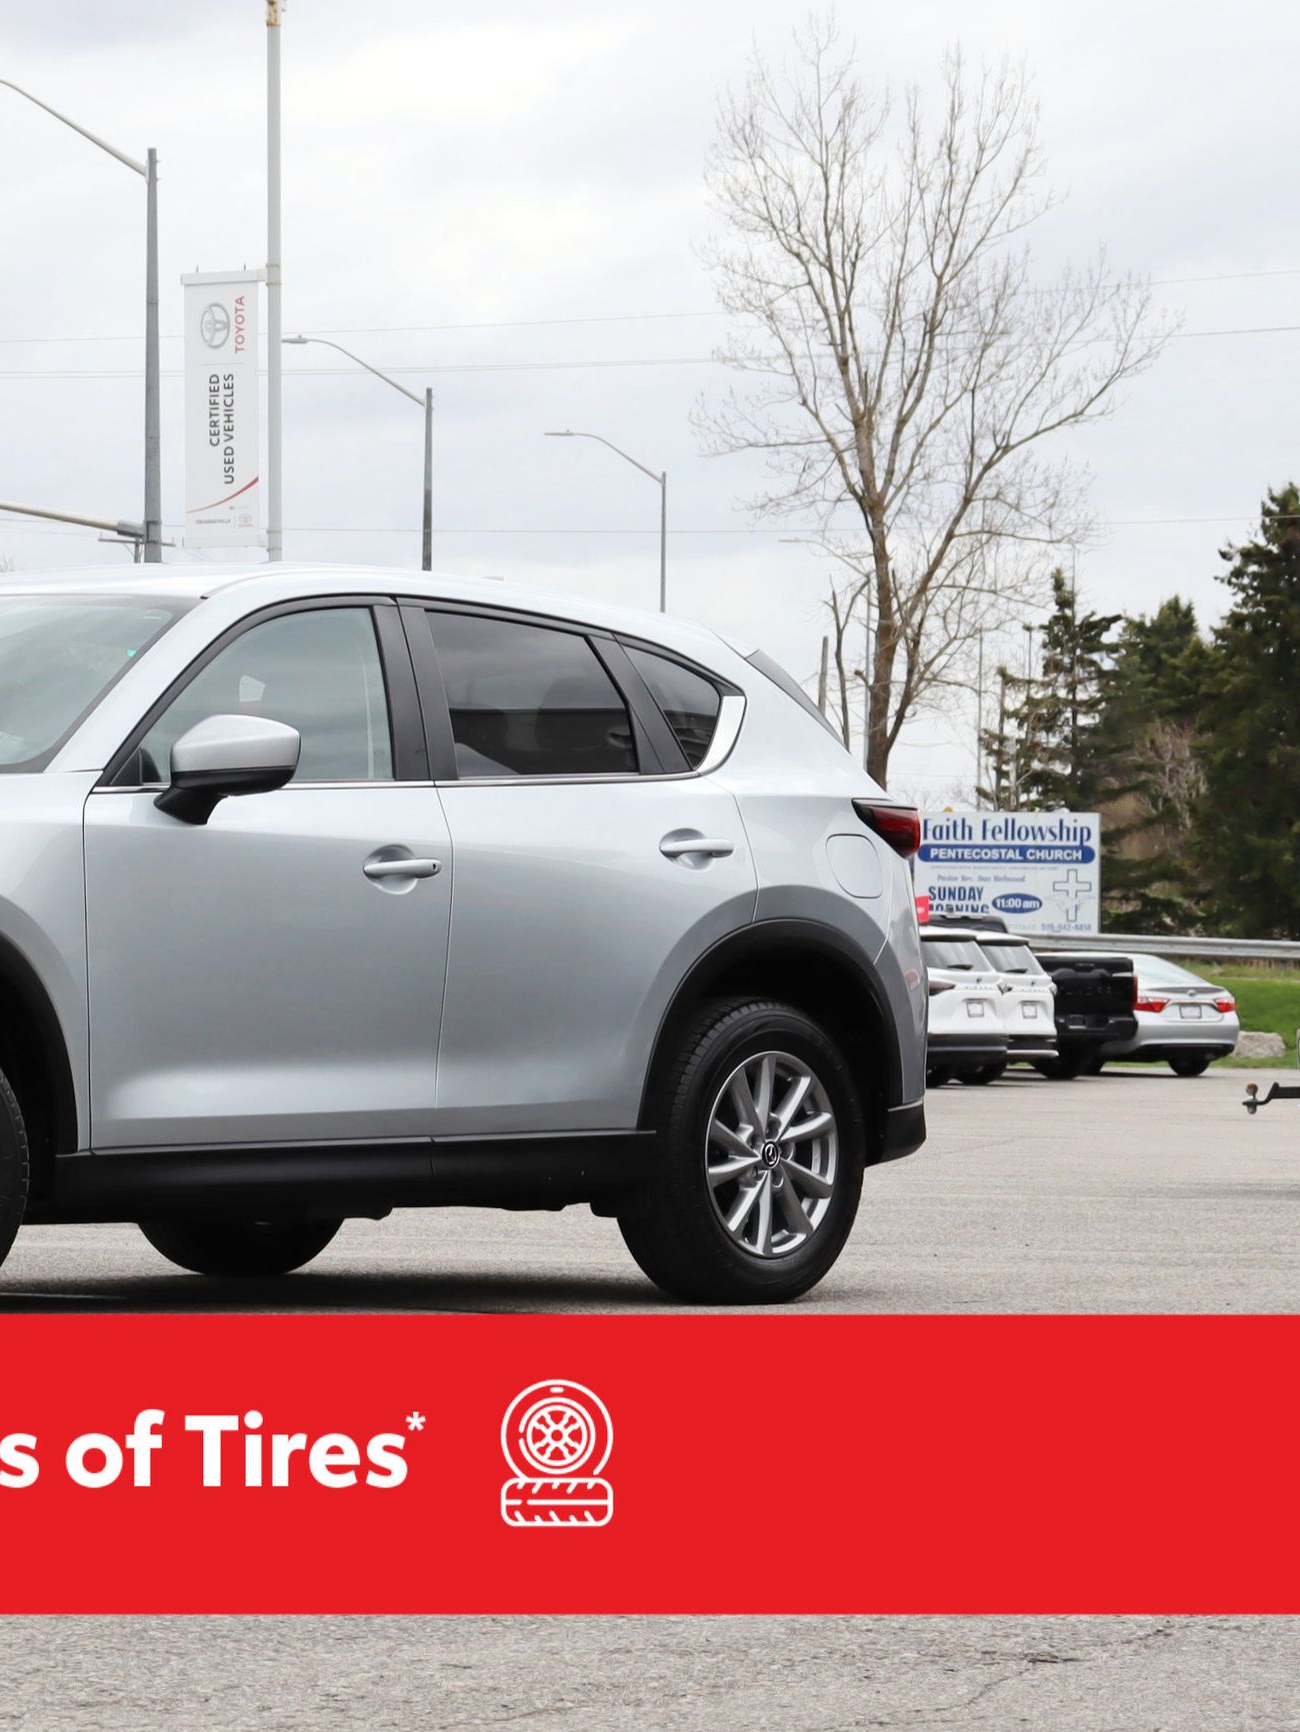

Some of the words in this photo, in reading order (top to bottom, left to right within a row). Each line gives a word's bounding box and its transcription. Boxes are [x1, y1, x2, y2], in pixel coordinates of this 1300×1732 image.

[235, 296, 246, 354] TOYOTA
[209, 373, 221, 448] CERTIFIED
[223, 373, 235, 443] VEHICLES
[224, 445, 235, 485] USED
[923, 818, 973, 842] Faith
[981, 818, 1092, 847] Fellowship
[930, 848, 1023, 860] PENTECOSTAL
[1026, 849, 1083, 861] CHURCH
[928, 886, 985, 901] SUNDAY
[995, 898, 1022, 909] 11:00
[1022, 900, 1040, 909] am
